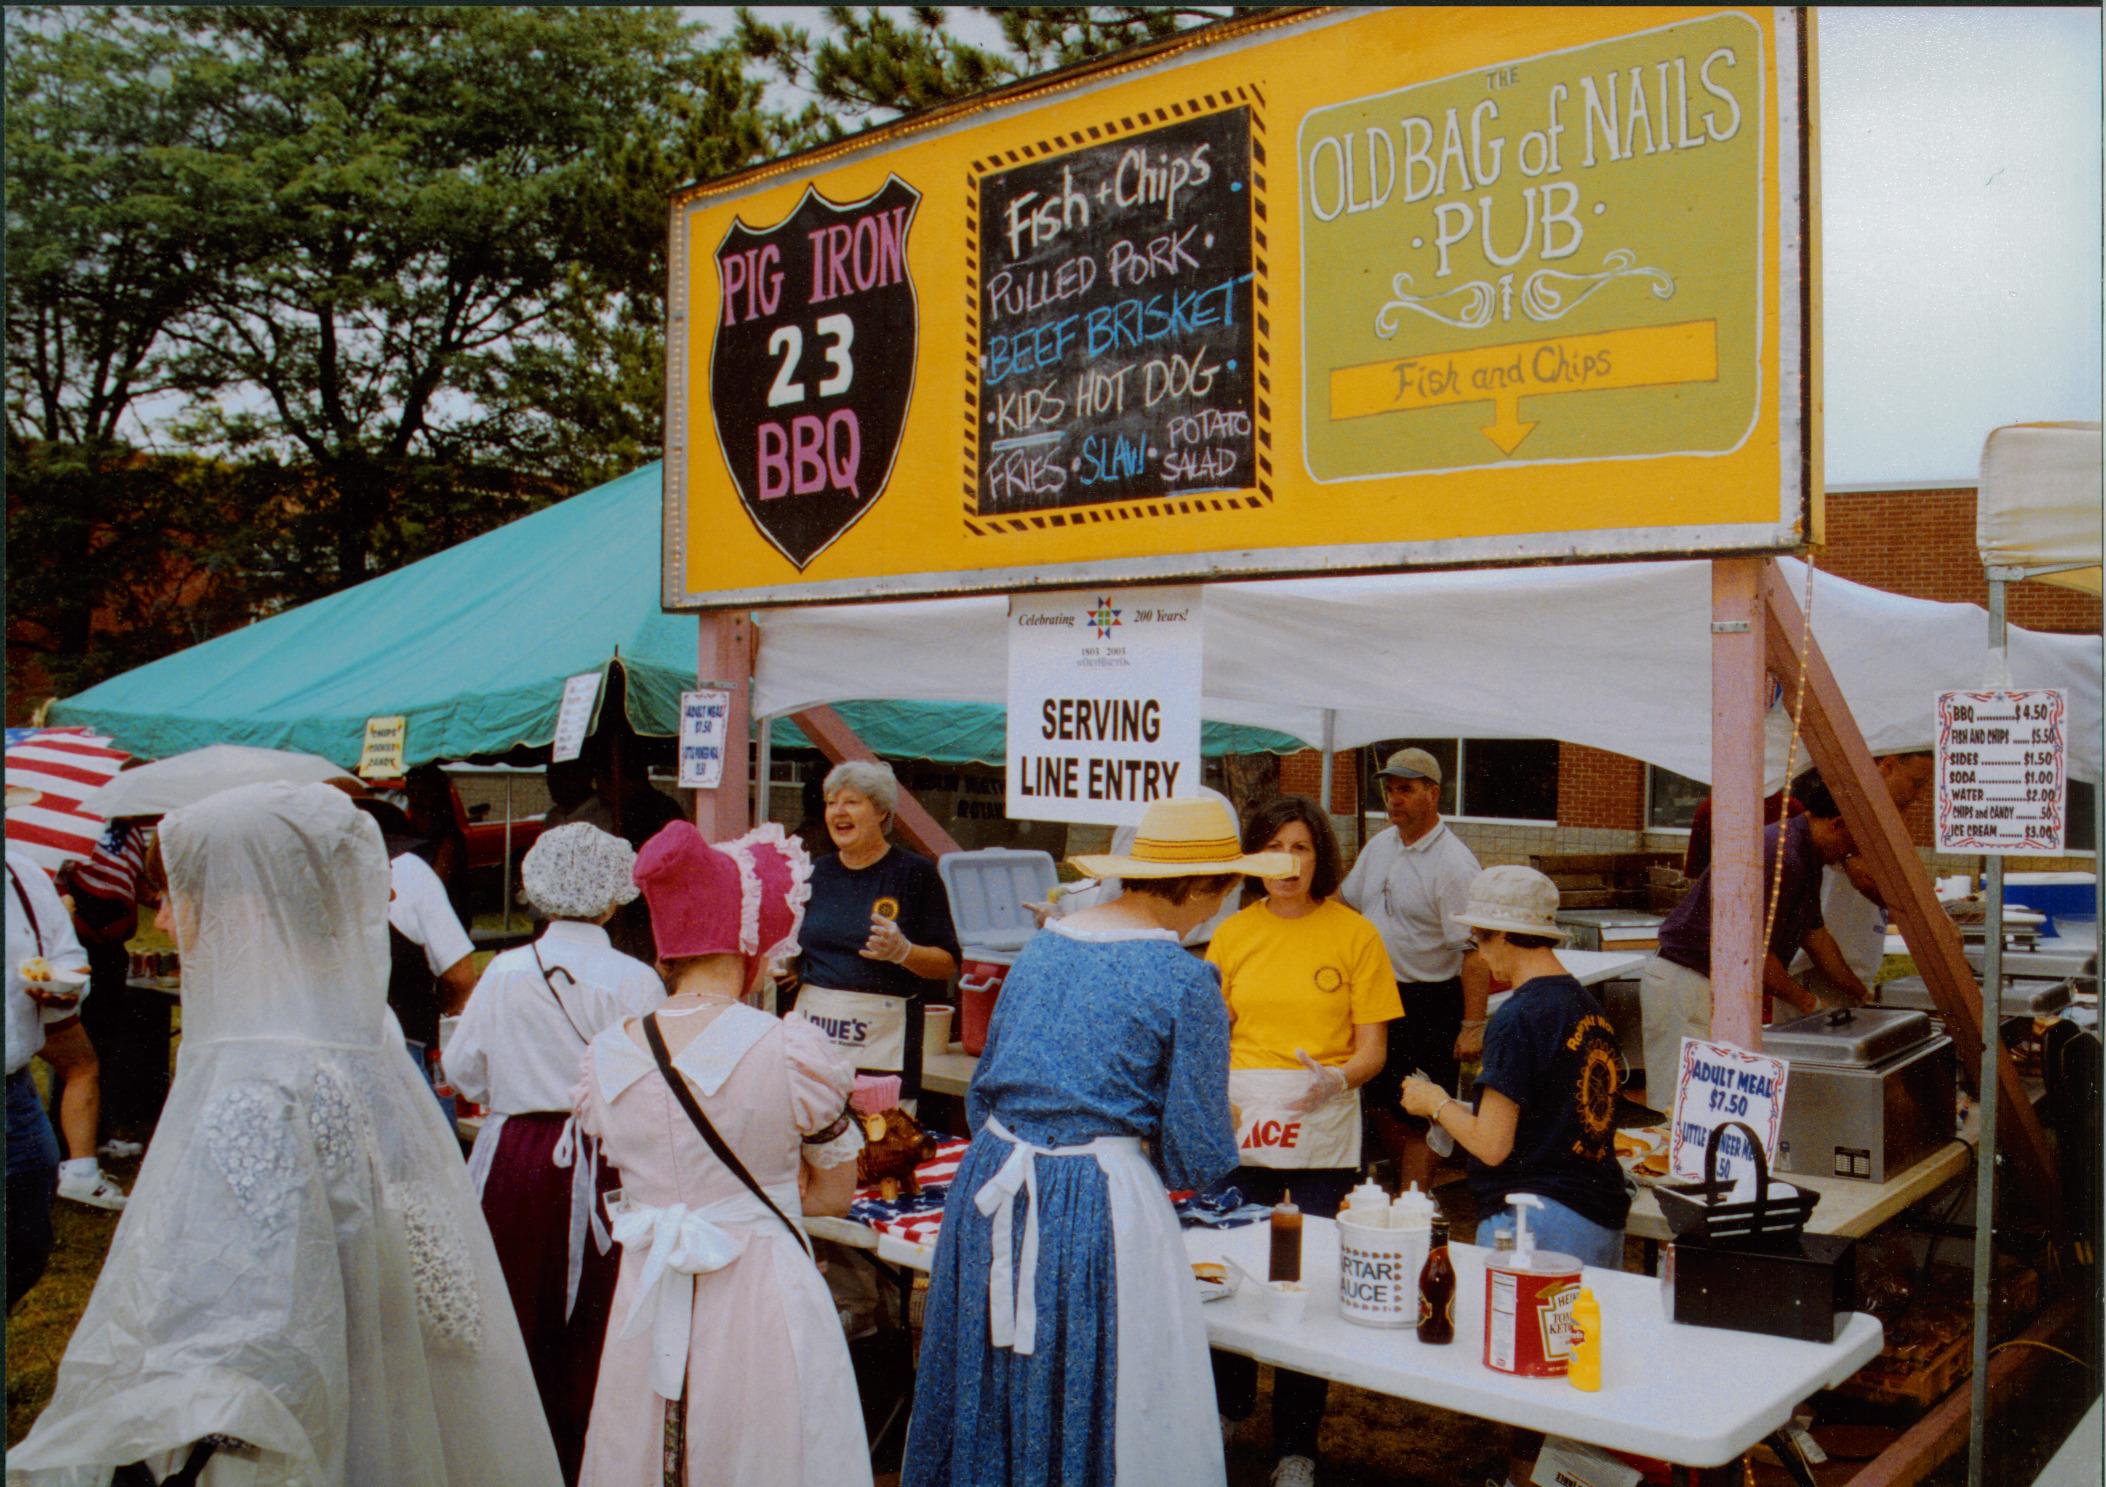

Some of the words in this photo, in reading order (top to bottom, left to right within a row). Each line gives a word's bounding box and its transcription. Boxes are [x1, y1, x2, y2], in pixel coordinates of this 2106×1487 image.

[1486, 66, 1519, 89] THE
[1309, 127, 1396, 222] OLD
[1401, 99, 1506, 203] BAG
[1518, 83, 1568, 176] of
[1580, 47, 1741, 168] NAILS
[1115, 143, 1211, 220] Chips
[1434, 182, 1584, 278] PUB
[724, 243, 784, 326] PIG
[808, 206, 906, 304] IRON
[987, 256, 1096, 319] PULLED
[1109, 225, 1199, 286] PORK
[985, 314, 1079, 385] BEEF
[1086, 271, 1256, 357] BRISKET
[767, 313, 854, 408] 23
[1393, 361, 1460, 401] Fish
[1471, 354, 1524, 391] and
[1532, 345, 1612, 384] Chips
[998, 380, 1065, 434] KIDS
[1076, 364, 1135, 417] HOT
[1144, 345, 1220, 408] DOG
[1167, 410, 1250, 447] POTATO
[758, 408, 861, 500] BBQ
[986, 452, 1067, 499] FRIES
[1080, 431, 1147, 484] SLAW
[1162, 449, 1237, 482] SALAD
[1019, 612, 1075, 627] Celebrating
[1133, 610, 1152, 622] 200
[1156, 609, 1189, 622] Years!
[1042, 698, 1160, 743] SERVING
[1953, 705, 1974, 723] BBQ
[1951, 729, 1968, 745] FISH
[1969, 729, 1985, 745] AND
[1987, 729, 2009, 744] CHIPS
[2031, 728, 2055, 746] $5.50
[1949, 752, 1979, 766] SIDES
[2024, 751, 2052, 766] $1.50
[1021, 756, 1078, 798] LINE
[1088, 758, 1180, 802] ENTRY
[1949, 771, 1976, 784] SODA
[2024, 771, 2053, 785] $1.00
[1951, 788, 1984, 801] WATER
[2026, 788, 2055, 803] $2.00
[1952, 805, 1974, 819] CHIPS
[1975, 806, 1989, 819] and
[1990, 805, 2015, 819] CANDY
[1950, 824, 1965, 837] ICE
[1966, 824, 1997, 837] CREAM
[2025, 826, 2052, 839] $3.00
[1692, 1059, 1736, 1089] ADULT
[1737, 1071, 1772, 1099] MEAL
[1708, 1088, 1748, 1117] $7.50
[1241, 1120, 1302, 1149] ACE
[1682, 1121, 1707, 1148] LITTLE
